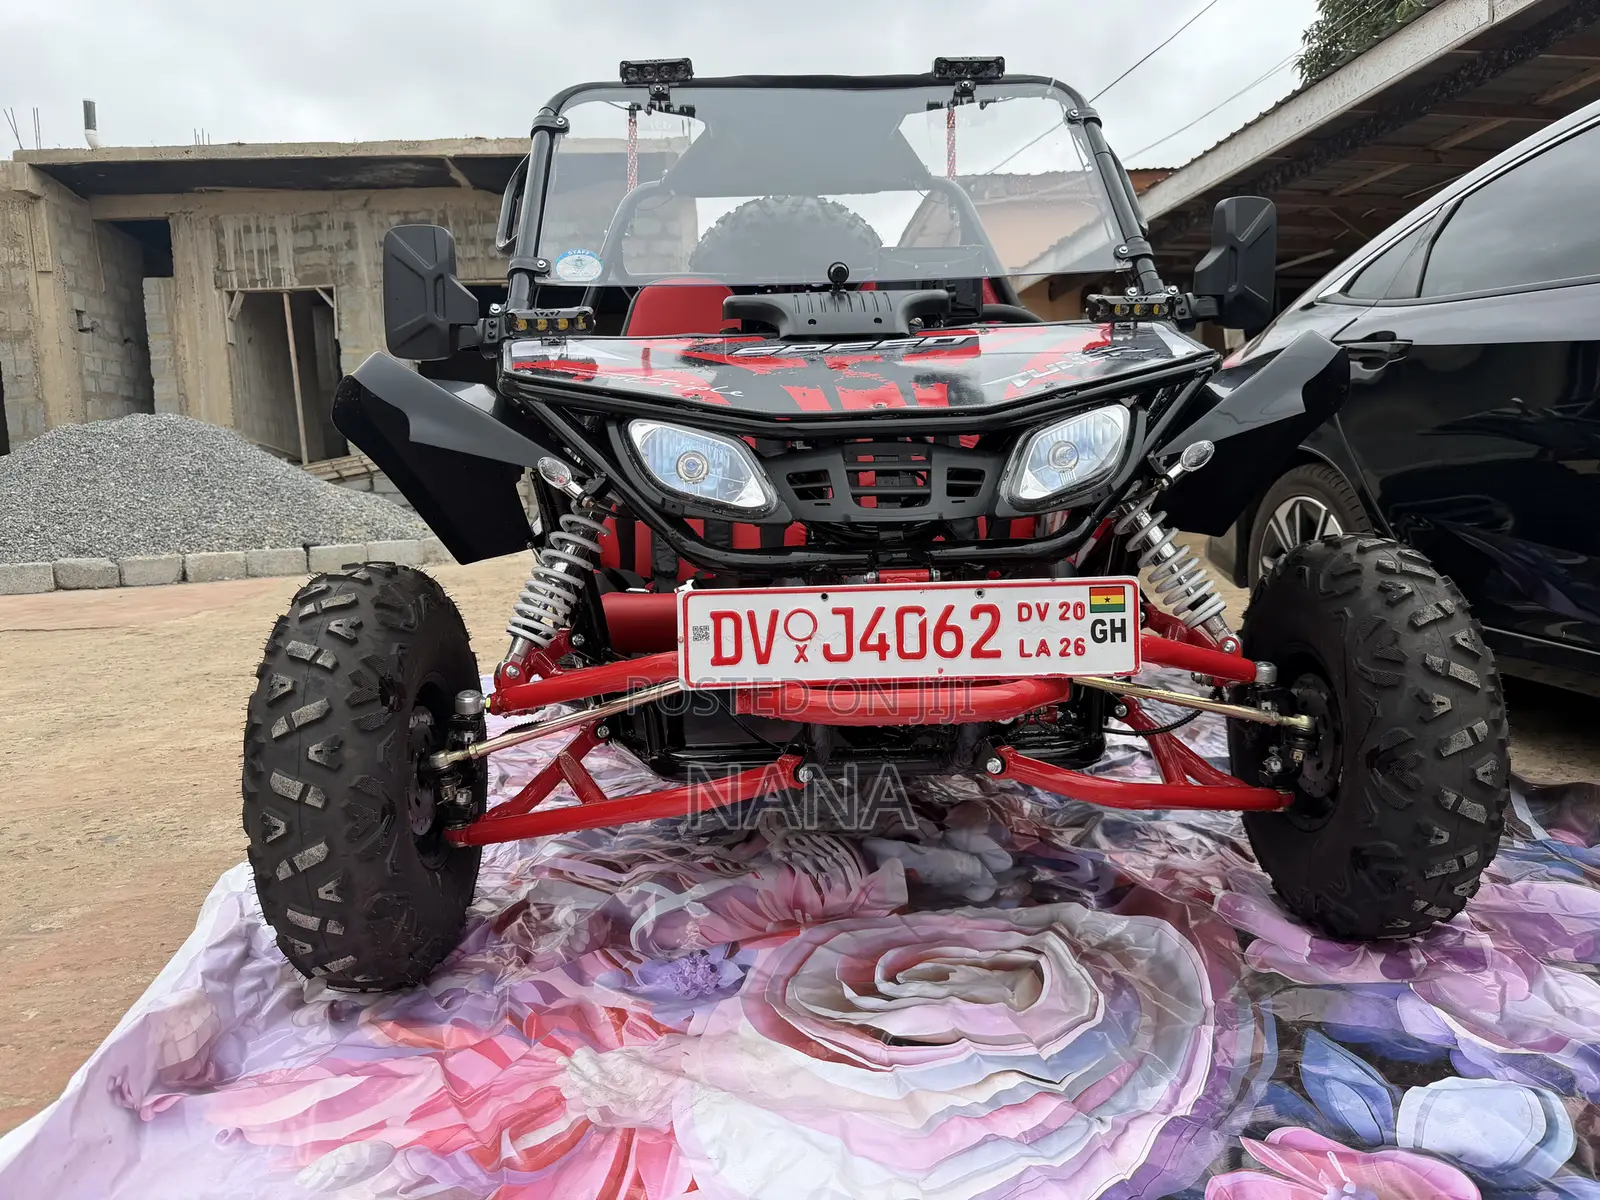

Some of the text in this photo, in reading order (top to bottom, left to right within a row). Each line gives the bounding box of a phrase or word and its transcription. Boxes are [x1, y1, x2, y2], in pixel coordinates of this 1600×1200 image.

[728, 335, 974, 356] SPEED
[1017, 601, 1086, 623] DV 20
[1090, 618, 1127, 644] GH
[1019, 637, 1087, 659] LA 26
